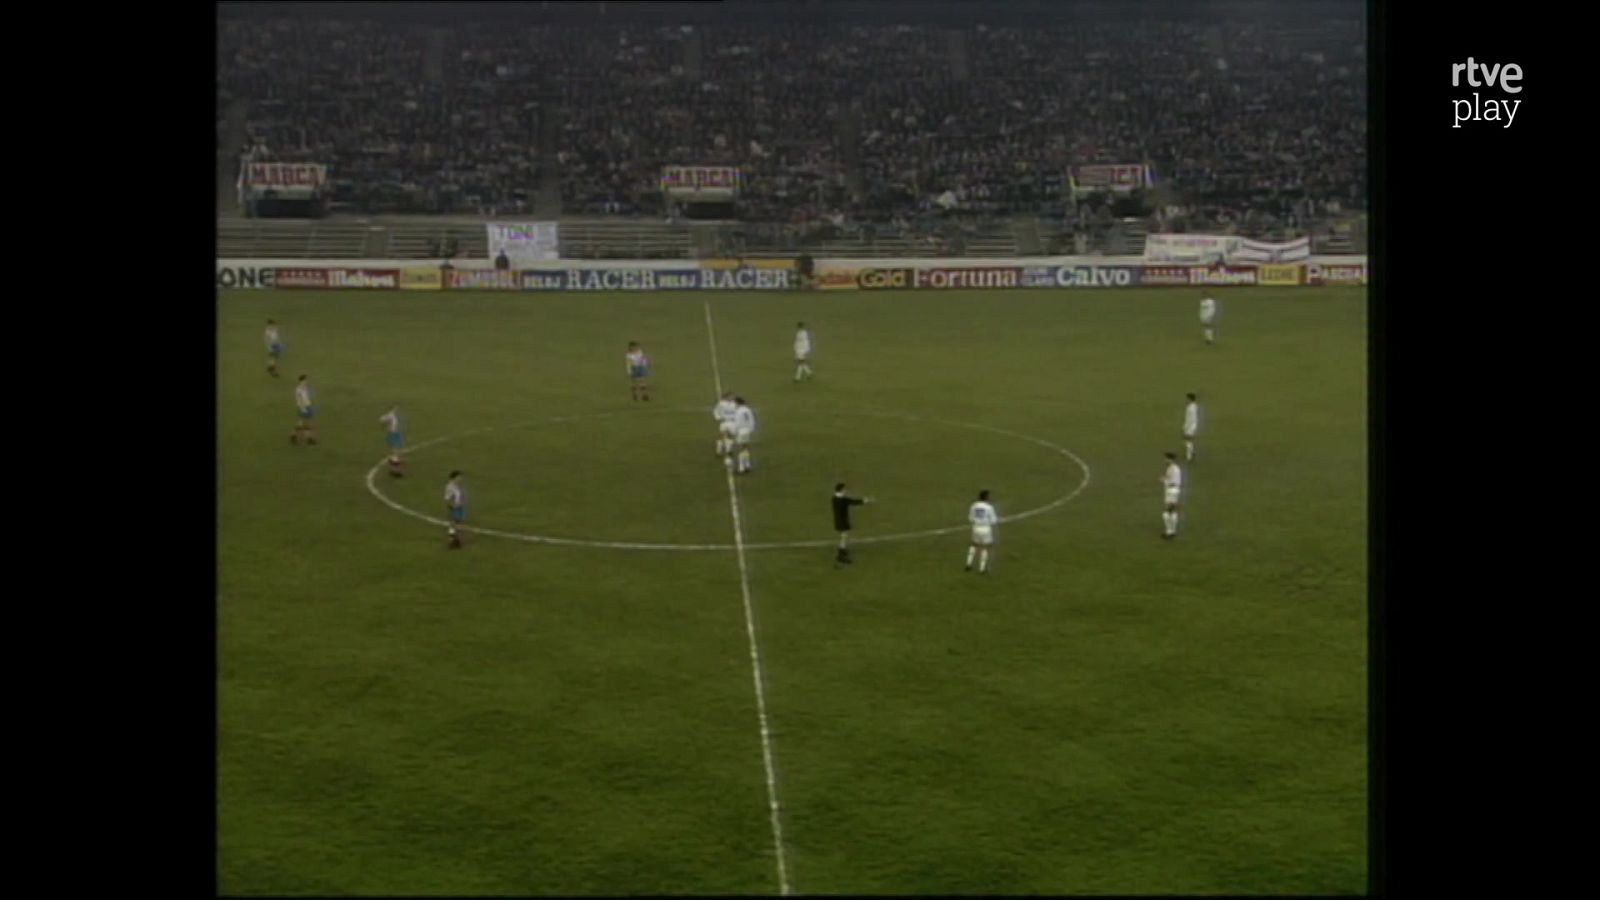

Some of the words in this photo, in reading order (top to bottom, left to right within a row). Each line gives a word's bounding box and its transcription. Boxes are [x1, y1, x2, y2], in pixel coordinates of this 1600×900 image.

[667, 168, 734, 189] MARCA
[566, 269, 657, 290] RACER
[700, 269, 790, 290] RACER
[860, 268, 906, 289] Gold
[914, 267, 1017, 288] Fortuna
[1056, 266, 1131, 286] Calvo
